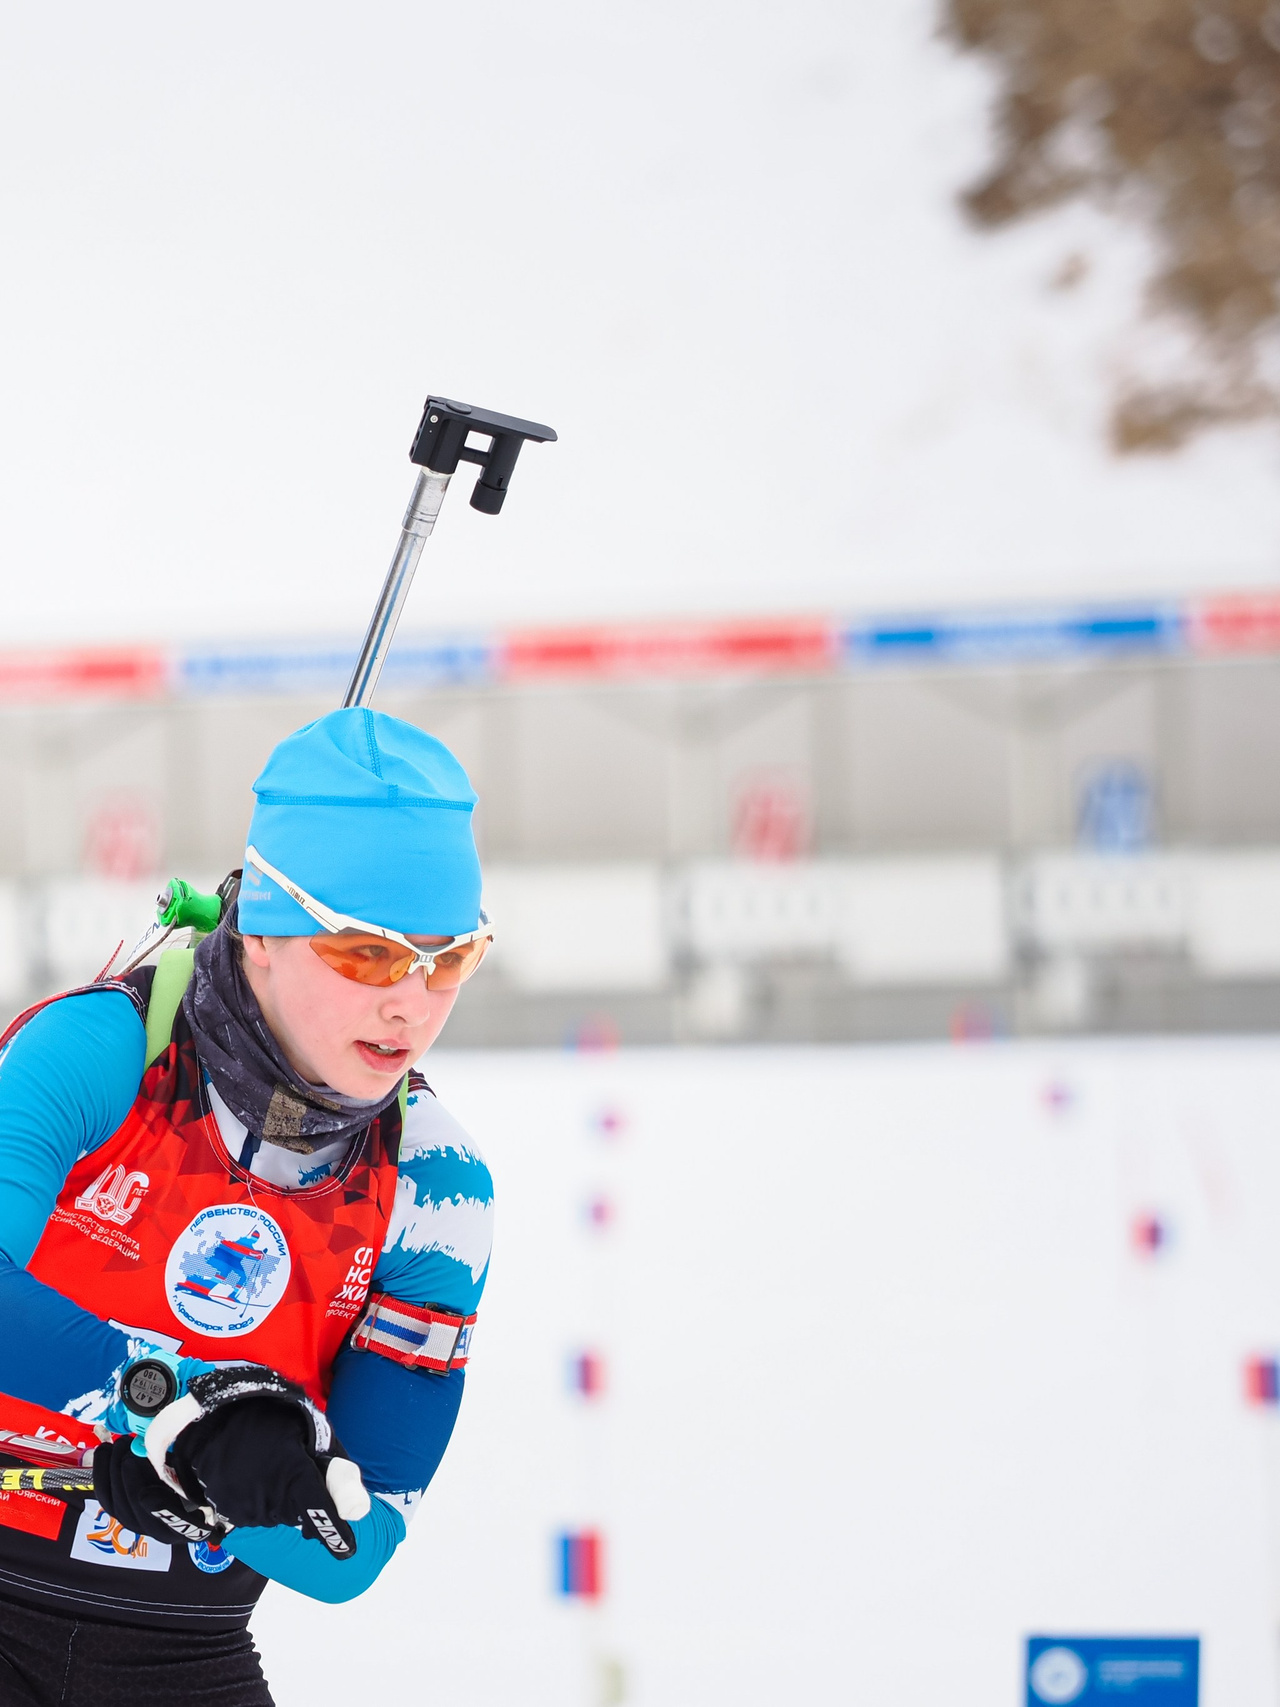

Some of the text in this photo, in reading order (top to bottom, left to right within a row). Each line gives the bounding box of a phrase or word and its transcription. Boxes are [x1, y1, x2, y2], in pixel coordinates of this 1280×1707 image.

[131, 1187, 149, 1197] ЛЕТ
[54, 1205, 140, 1250] ИНИСТЕРСТВО СПОРТА
[189, 1207, 287, 1256] ПЕРВЕНСТВО РОССИИ
[90, 1233, 140, 1261] ФЕДЕРАЦИИ
[176, 1302, 223, 1331] Красноярск
[228, 1316, 255, 1331] 2023
[143, 1369, 157, 1381] 180
